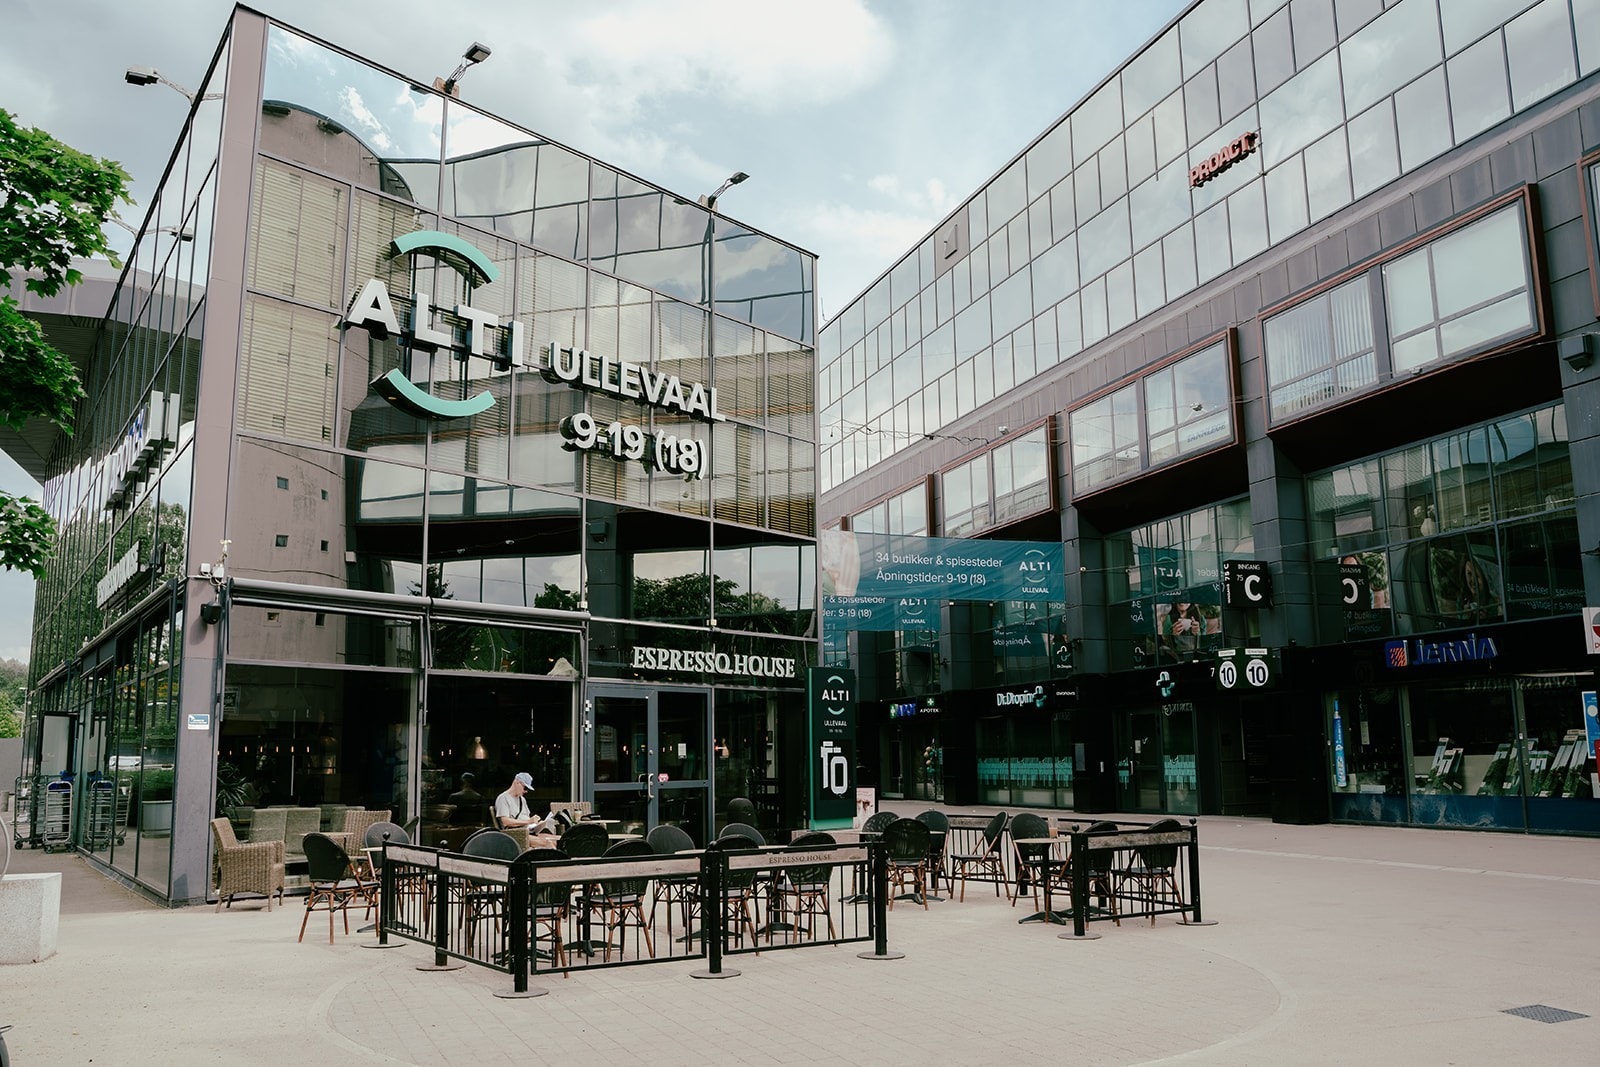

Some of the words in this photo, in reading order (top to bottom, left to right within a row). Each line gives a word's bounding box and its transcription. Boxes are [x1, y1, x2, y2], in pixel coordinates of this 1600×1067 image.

[1189, 132, 1252, 187] PROACT
[345, 279, 523, 367] ALTI
[550, 342, 726, 422] ULLEVAAL
[572, 412, 645, 460] 9-19
[655, 429, 707, 480] (18)
[876, 552, 889, 563] 34
[892, 553, 934, 565] butikker
[936, 555, 944, 566] &
[946, 556, 1003, 568] spisesteder
[1018, 561, 1051, 571] ALTI
[876, 567, 944, 584] Åpningstider:
[946, 573, 968, 584] 9-19
[969, 573, 986, 586] (18)
[1236, 574, 1244, 582] 75
[1244, 574, 1263, 601] C
[829, 595, 836, 603] &
[837, 595, 886, 605] spisesteder
[899, 598, 927, 606] ALTI
[838, 608, 856, 617] 9-19
[858, 609, 872, 619] (18)
[632, 646, 733, 675] ESPRESSO
[734, 654, 796, 678] HOUSE
[1221, 667, 1235, 684] 10
[1249, 666, 1266, 683] 10
[821, 689, 849, 701] ALTI
[769, 856, 805, 864] ESPRESSO
[807, 854, 833, 862] HOUSE
